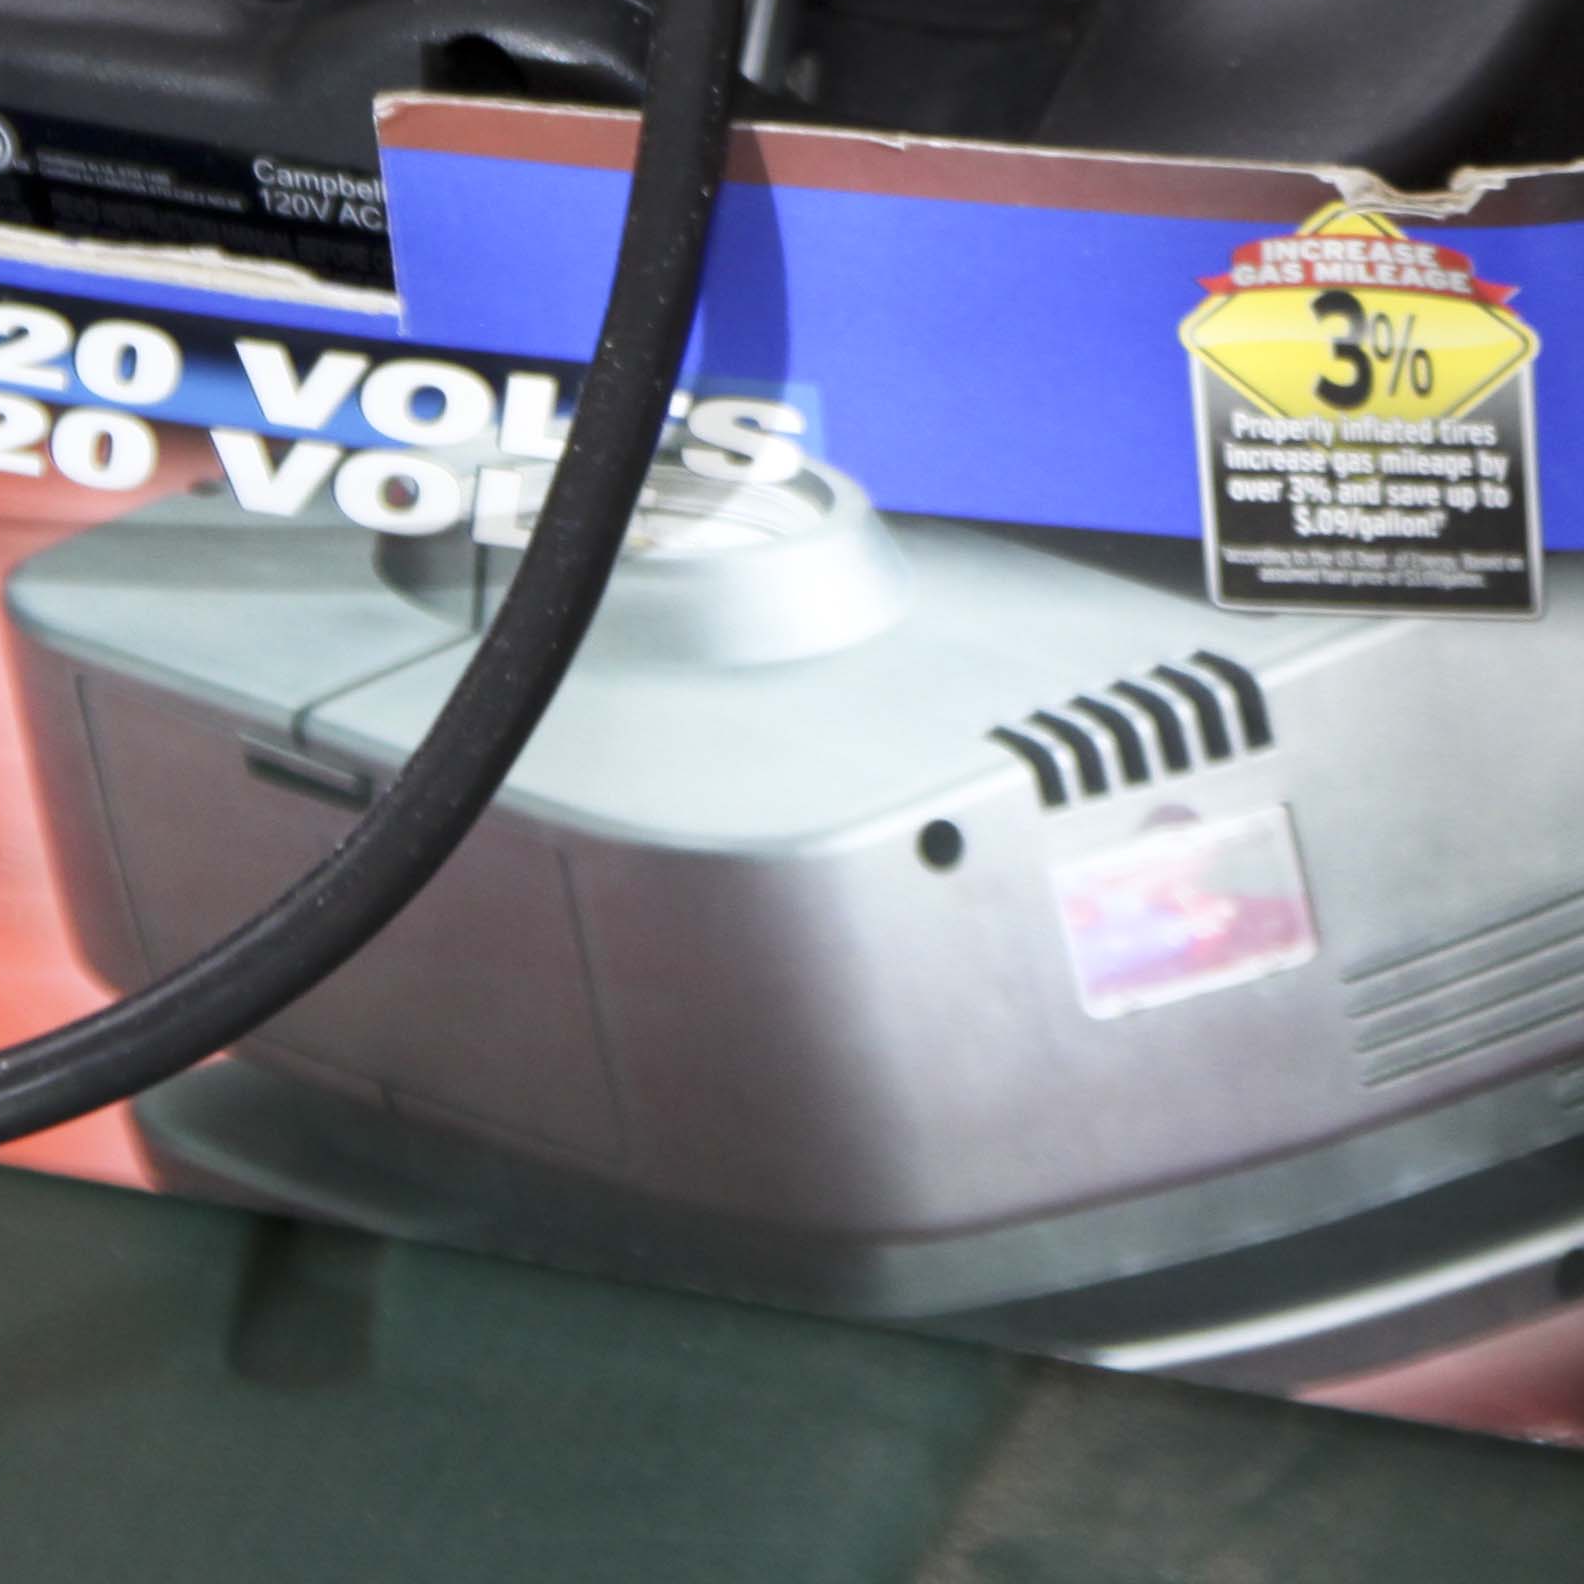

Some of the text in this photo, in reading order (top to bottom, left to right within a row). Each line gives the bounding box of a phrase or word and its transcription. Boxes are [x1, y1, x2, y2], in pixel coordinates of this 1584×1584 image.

[258, 188, 328, 223] 120V
[337, 203, 385, 233] AC
[1261, 239, 1438, 269] INCREASE
[1231, 262, 1475, 295] GAS MILEAGE
[1309, 288, 1435, 411] 3%
[235, 337, 807, 485] VOLS
[1231, 410, 1499, 448] Properly inflated tires
[1223, 440, 1510, 483] increase gas mileage by
[1225, 473, 1511, 513] over 3% and save up to
